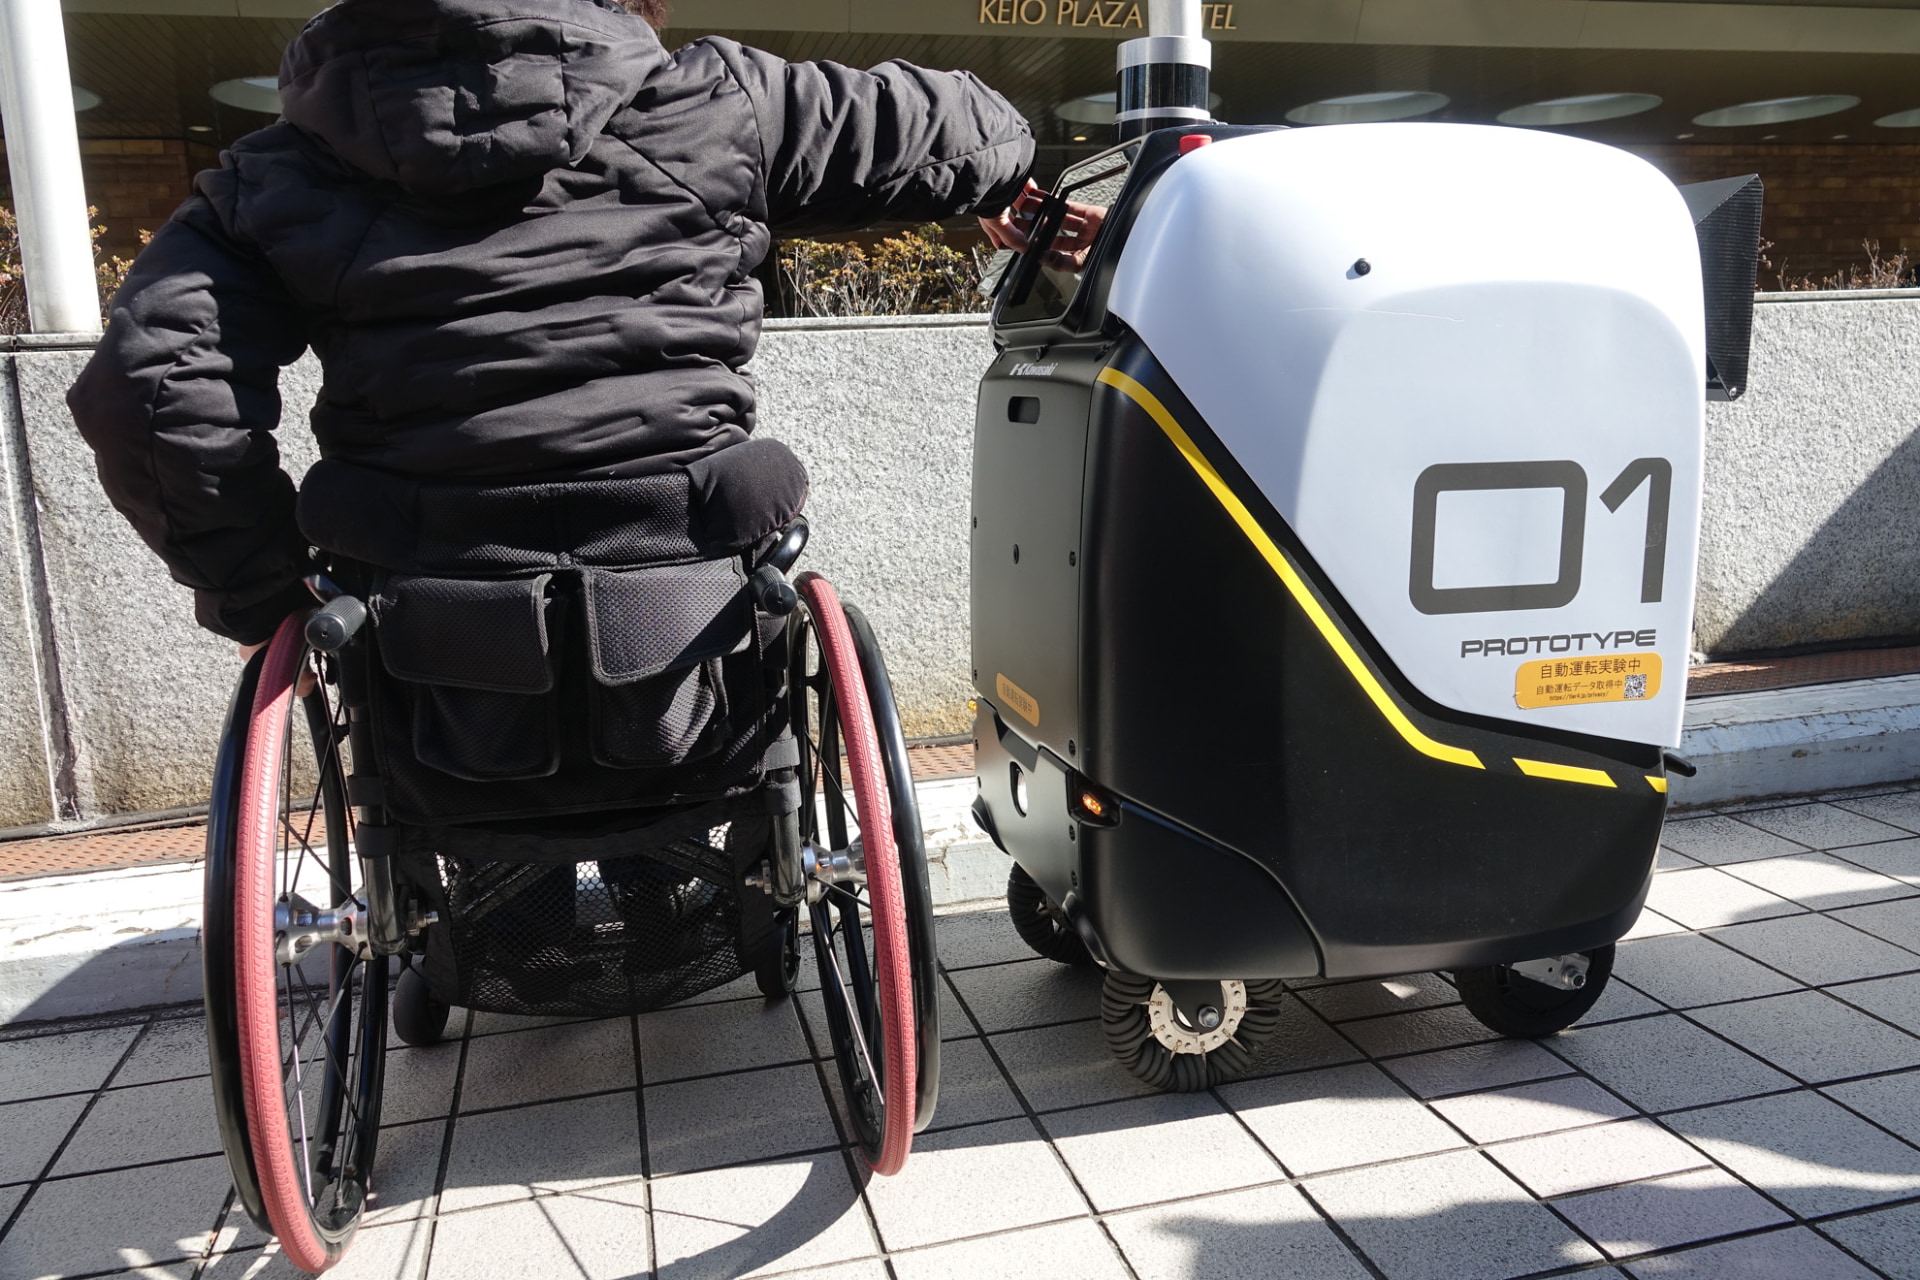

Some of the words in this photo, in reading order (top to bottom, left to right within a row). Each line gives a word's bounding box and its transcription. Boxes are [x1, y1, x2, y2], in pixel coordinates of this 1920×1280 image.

[979, 0, 1047, 25] KEIO
[1057, 1, 1143, 28] PLAZA
[1200, 4, 1237, 29] TEL
[1408, 457, 1673, 616] 01
[1460, 629, 1657, 658] PROTOTYPE
[1540, 657, 1641, 679] 自動運転実験中
[1536, 679, 1623, 695] 自動運転データ取得中
